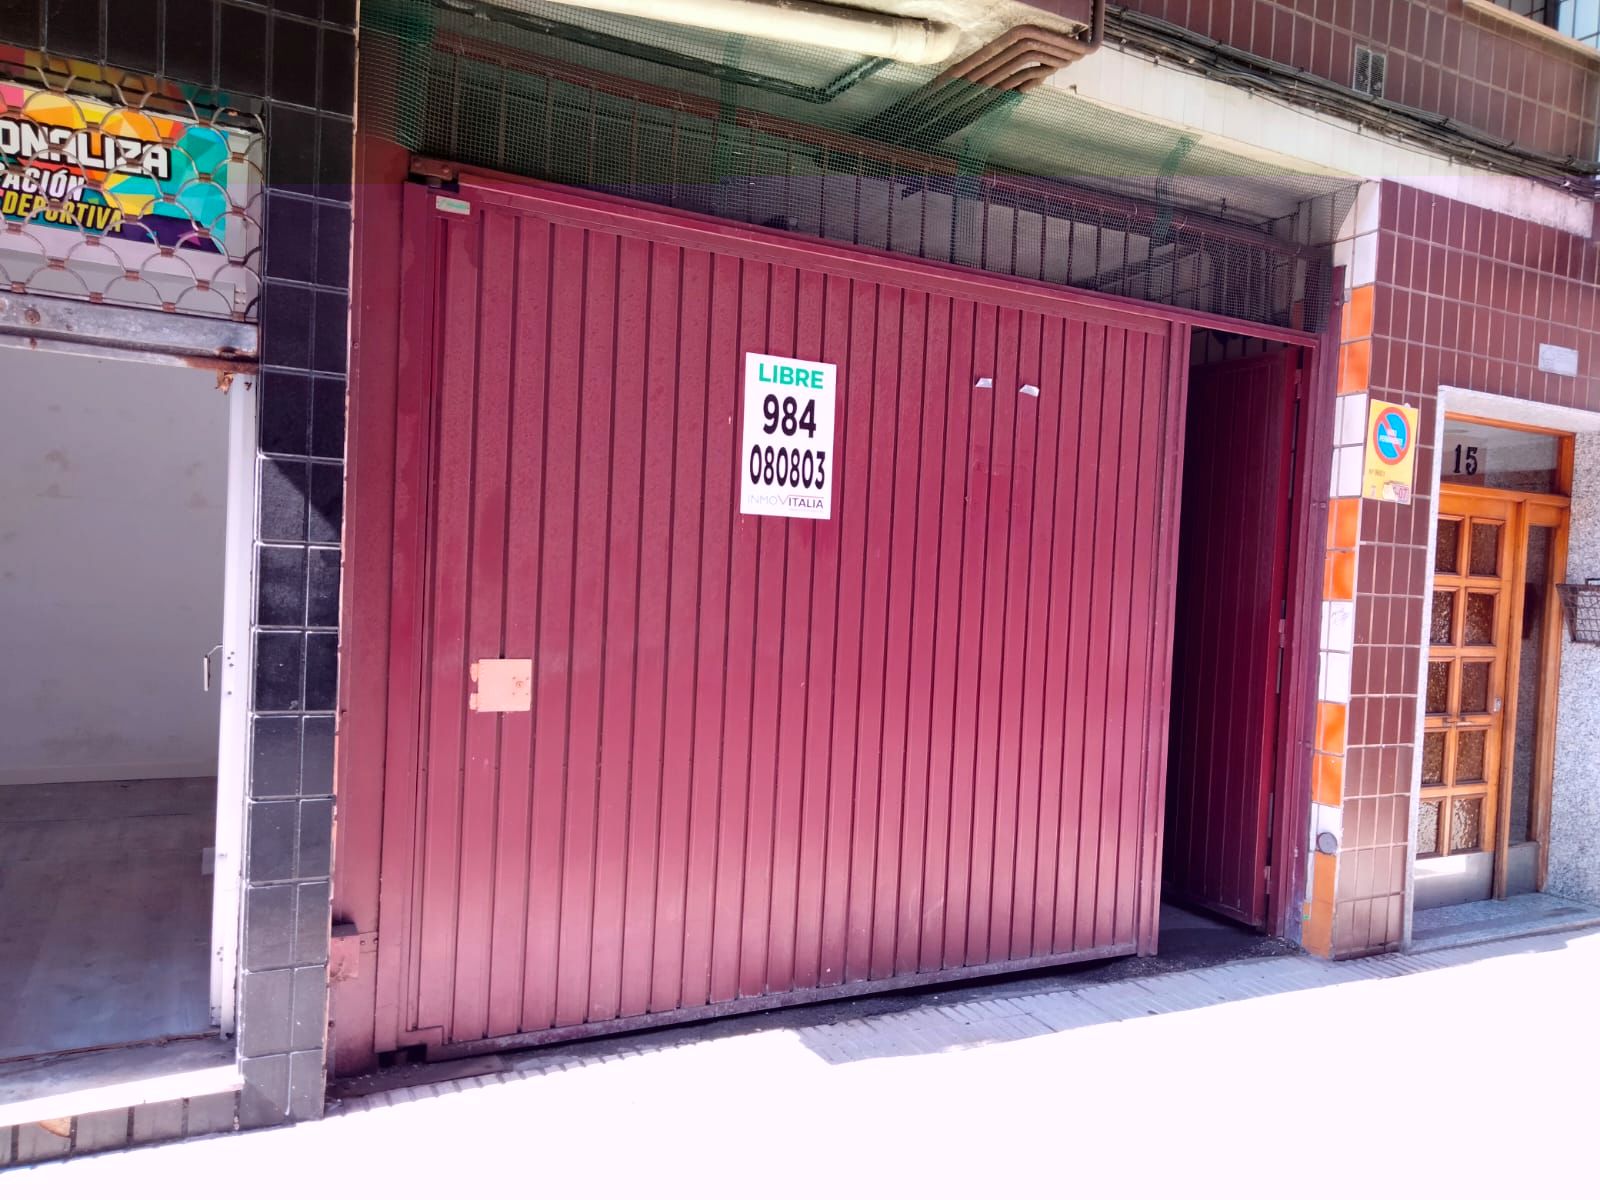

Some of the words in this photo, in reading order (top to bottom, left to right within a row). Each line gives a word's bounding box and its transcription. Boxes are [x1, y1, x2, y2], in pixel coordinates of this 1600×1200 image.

[2, 190, 122, 233] DEPORTIVA
[759, 363, 824, 389] LIBRE
[763, 394, 816, 438] 984
[750, 444, 825, 489] 080803
[1453, 444, 1478, 475] 15
